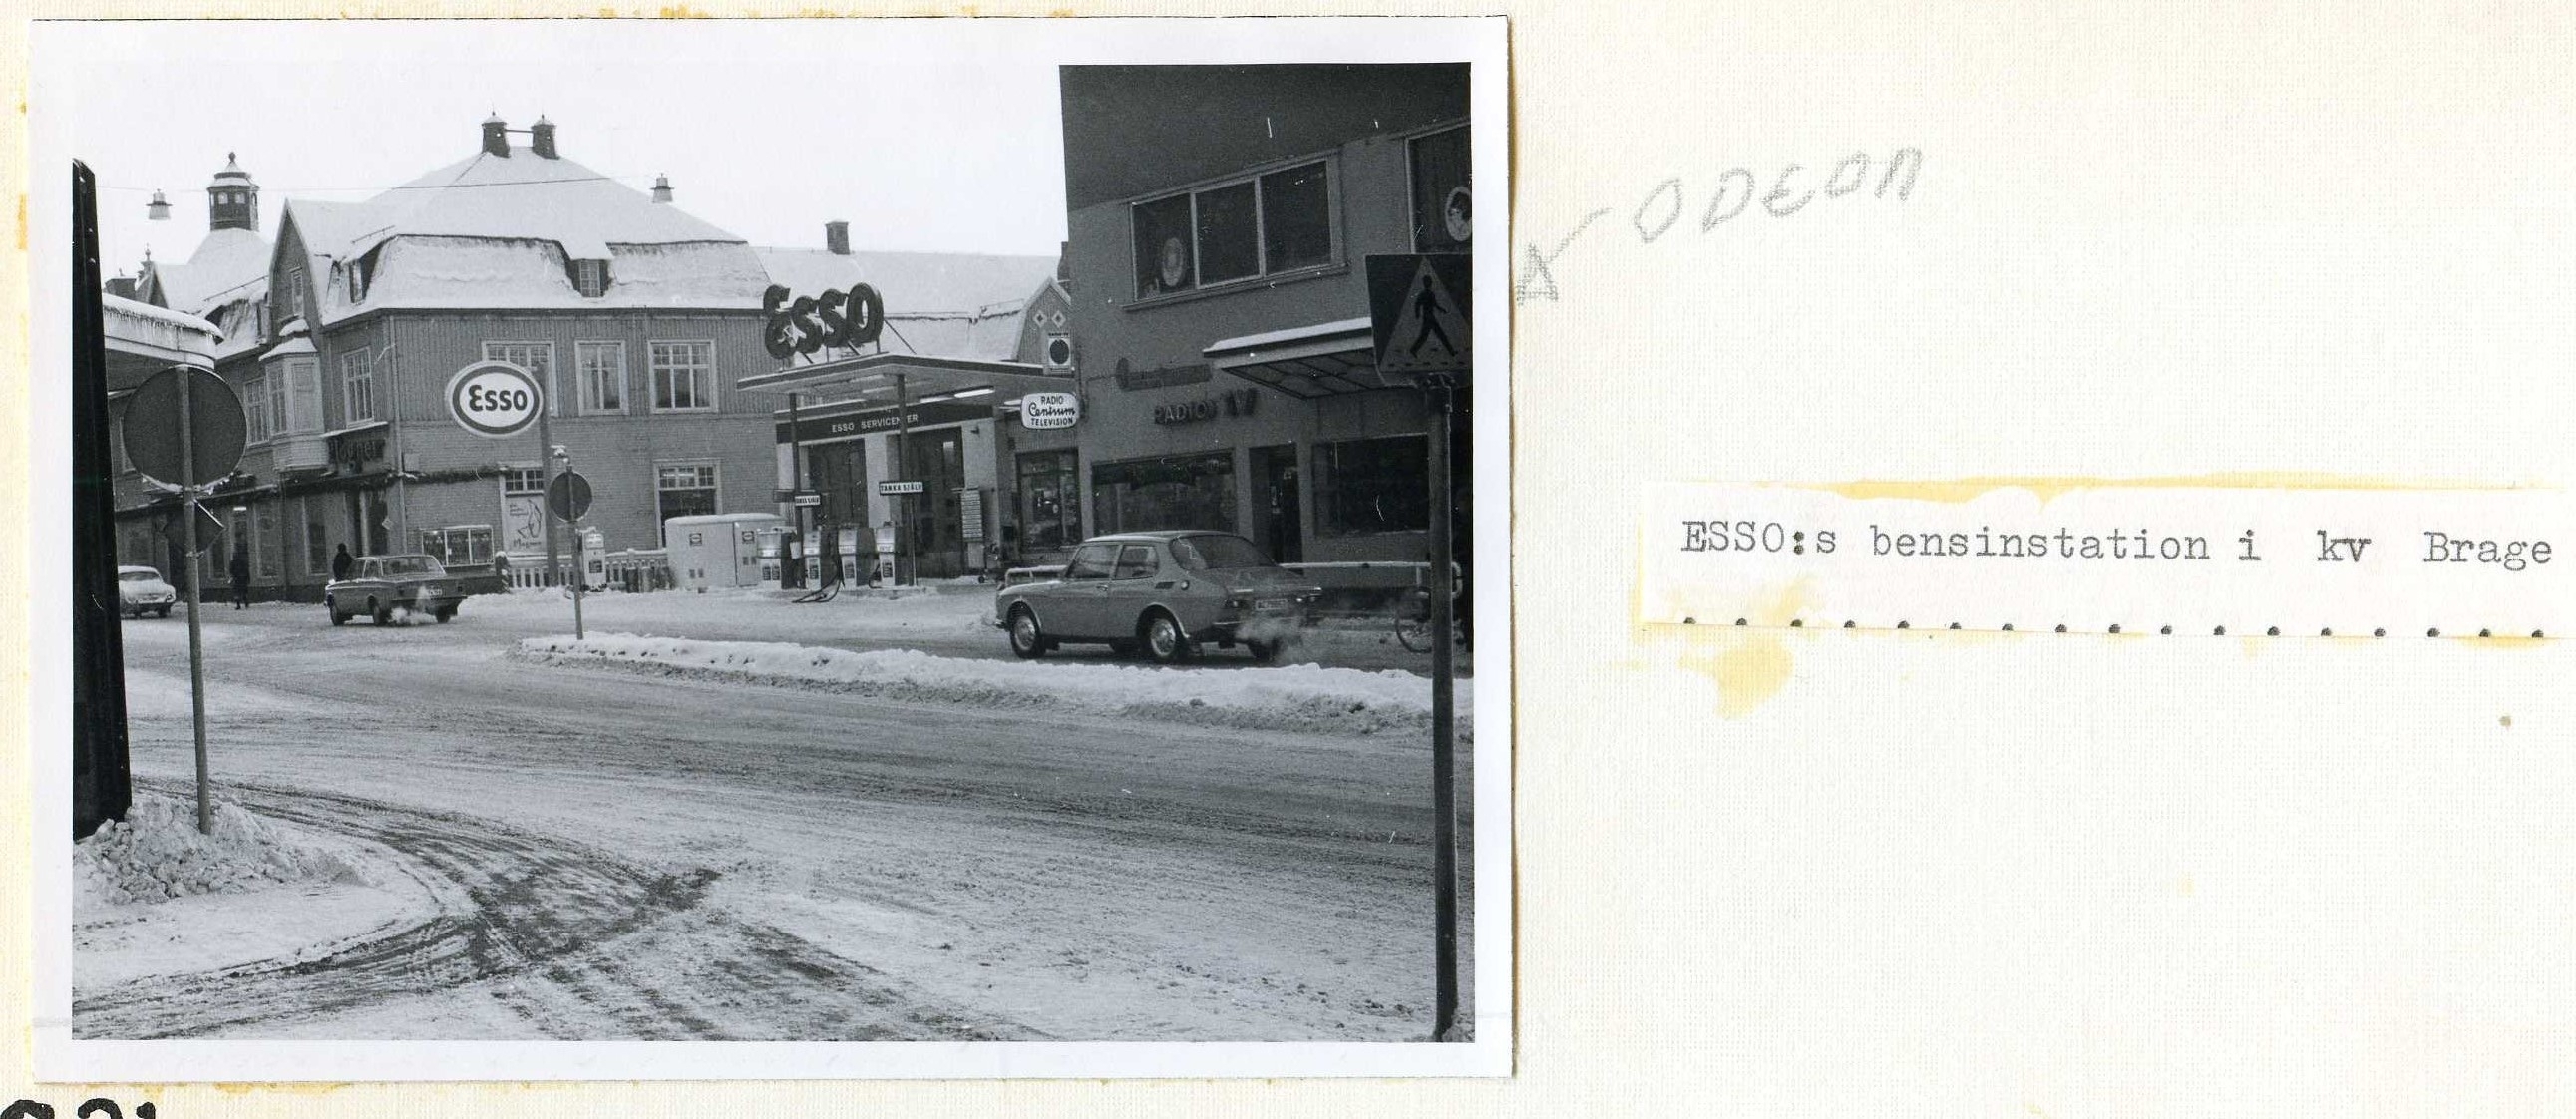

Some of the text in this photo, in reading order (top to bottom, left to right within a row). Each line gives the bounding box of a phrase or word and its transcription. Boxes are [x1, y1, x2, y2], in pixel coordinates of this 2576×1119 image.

[1041, 396, 1064, 405] RADIO
[1031, 417, 1073, 426] TELEVISION
[832, 422, 855, 433] ESSO
[1681, 520, 2553, 571] ESSO:s bensinstation i kv Brage
